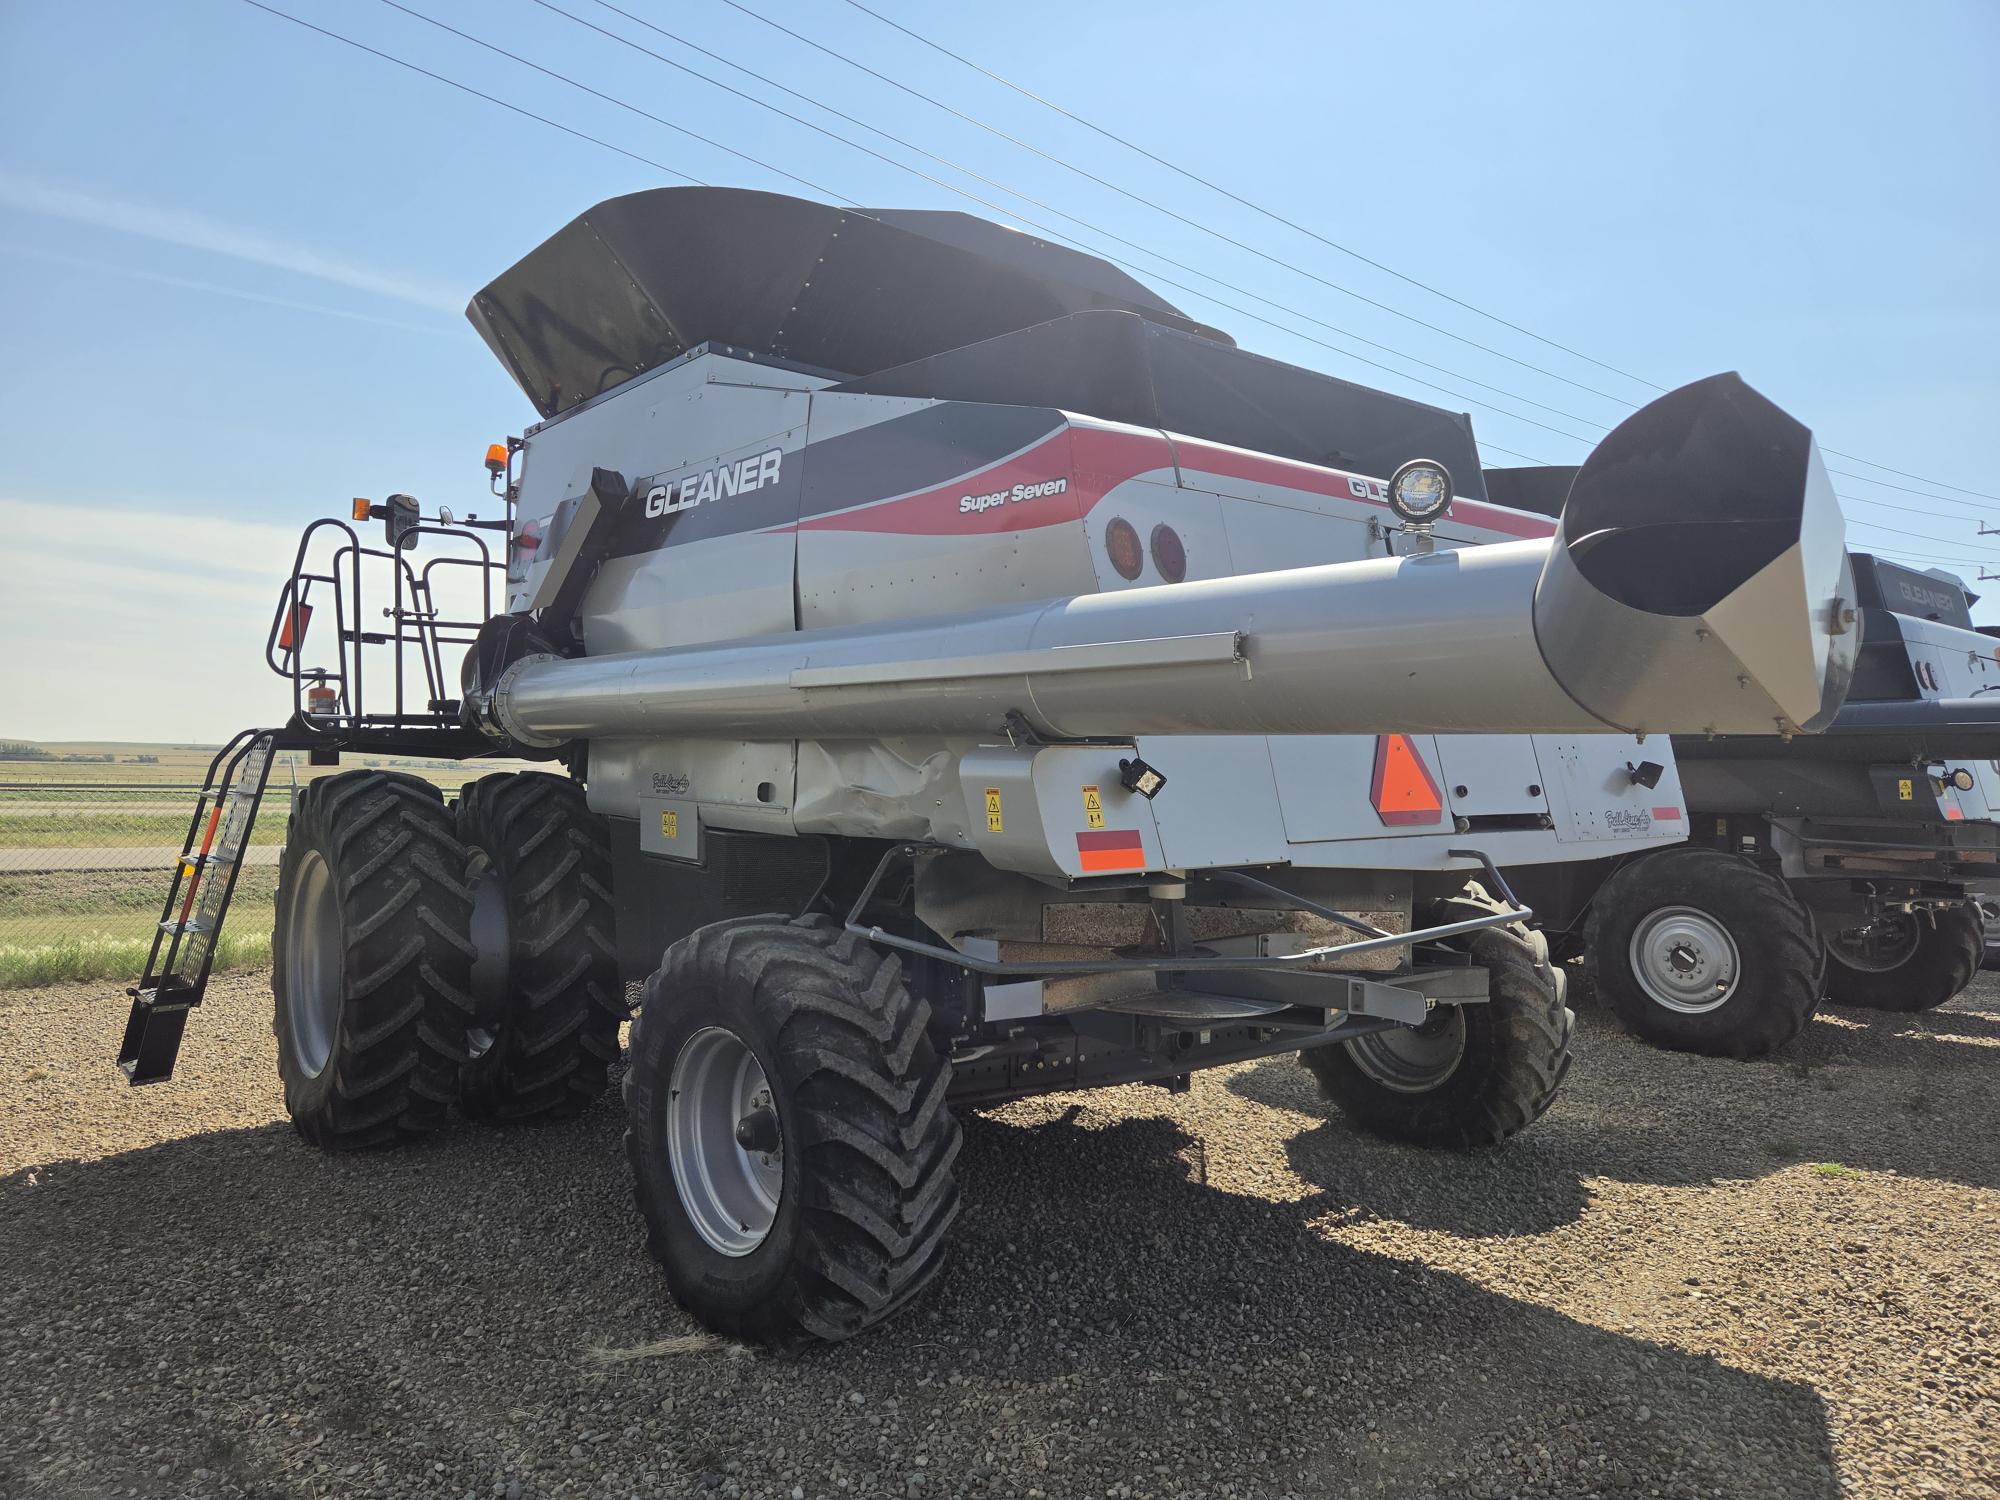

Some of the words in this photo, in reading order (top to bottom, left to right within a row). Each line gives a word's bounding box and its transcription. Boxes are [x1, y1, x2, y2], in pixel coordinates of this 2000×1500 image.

[645, 448, 782, 519] GLEANER
[960, 488, 1009, 513] Super
[1011, 478, 1067, 502] Seven
